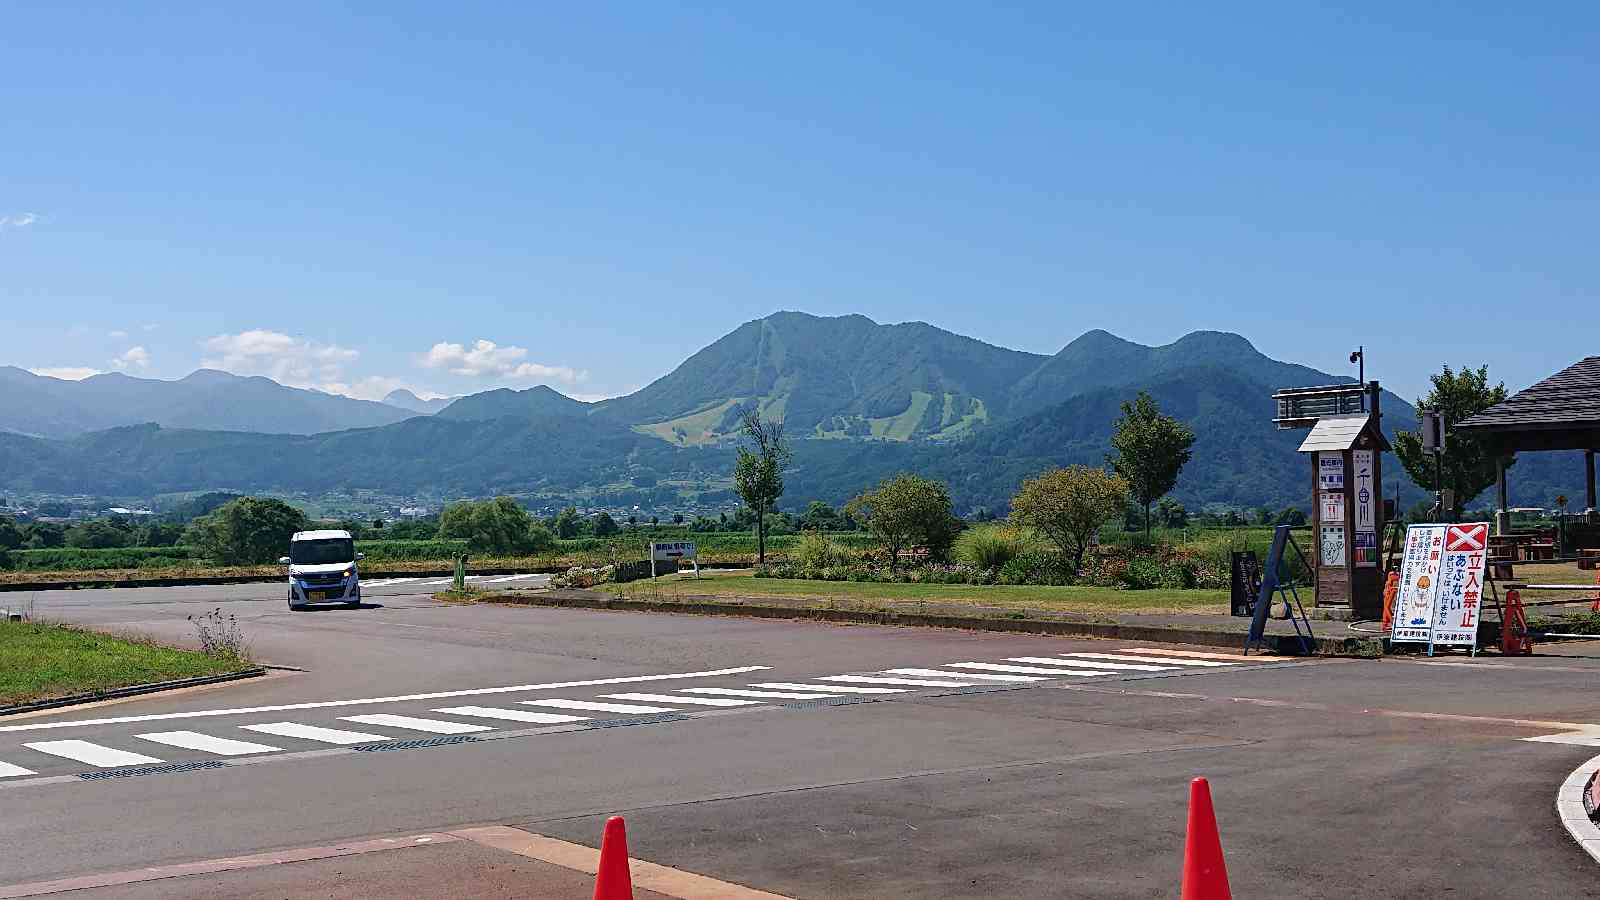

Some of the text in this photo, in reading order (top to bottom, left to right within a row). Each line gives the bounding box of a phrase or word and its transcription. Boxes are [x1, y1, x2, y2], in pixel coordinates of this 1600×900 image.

[1428, 536, 1442, 574] お願い
[1450, 554, 1467, 610] あぶない
[1460, 552, 1482, 627] 立入禁止
